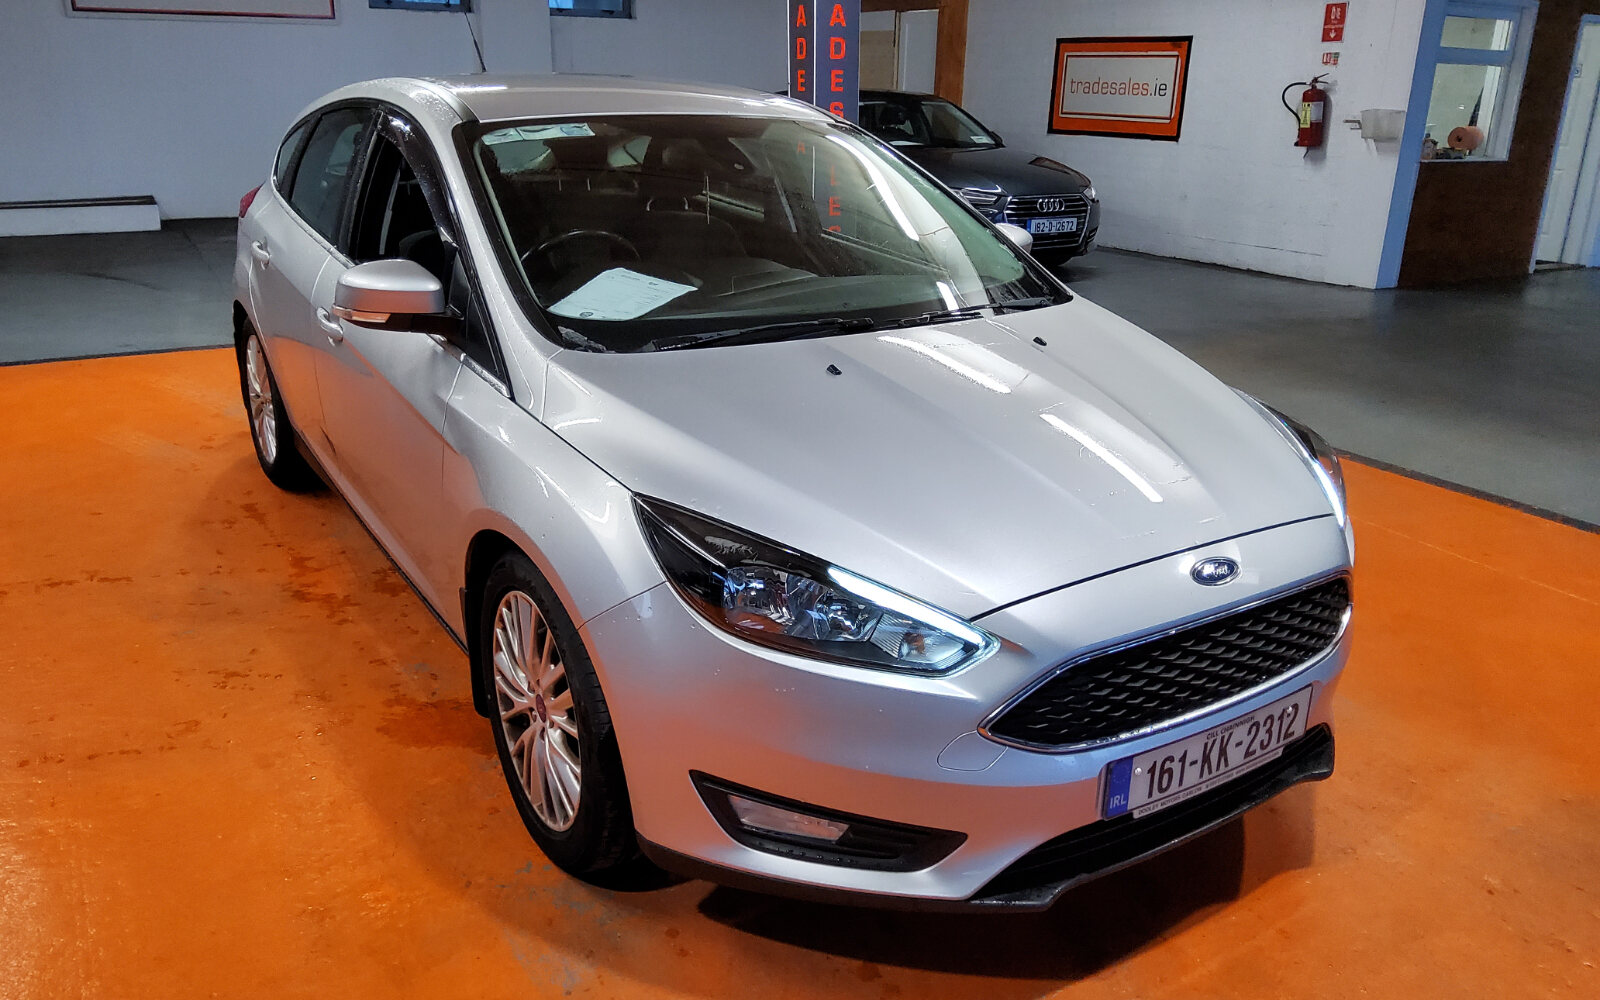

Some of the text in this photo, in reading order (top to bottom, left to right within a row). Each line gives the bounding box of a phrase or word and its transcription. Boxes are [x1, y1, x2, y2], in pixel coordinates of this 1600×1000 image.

[1070, 77, 1168, 97] tradesales.ie
[1034, 220, 1075, 233] 182-D-12672
[1206, 731, 1219, 740] CILL
[1146, 702, 1299, 800] 161-KK-2312
[1109, 793, 1127, 809] IRL
